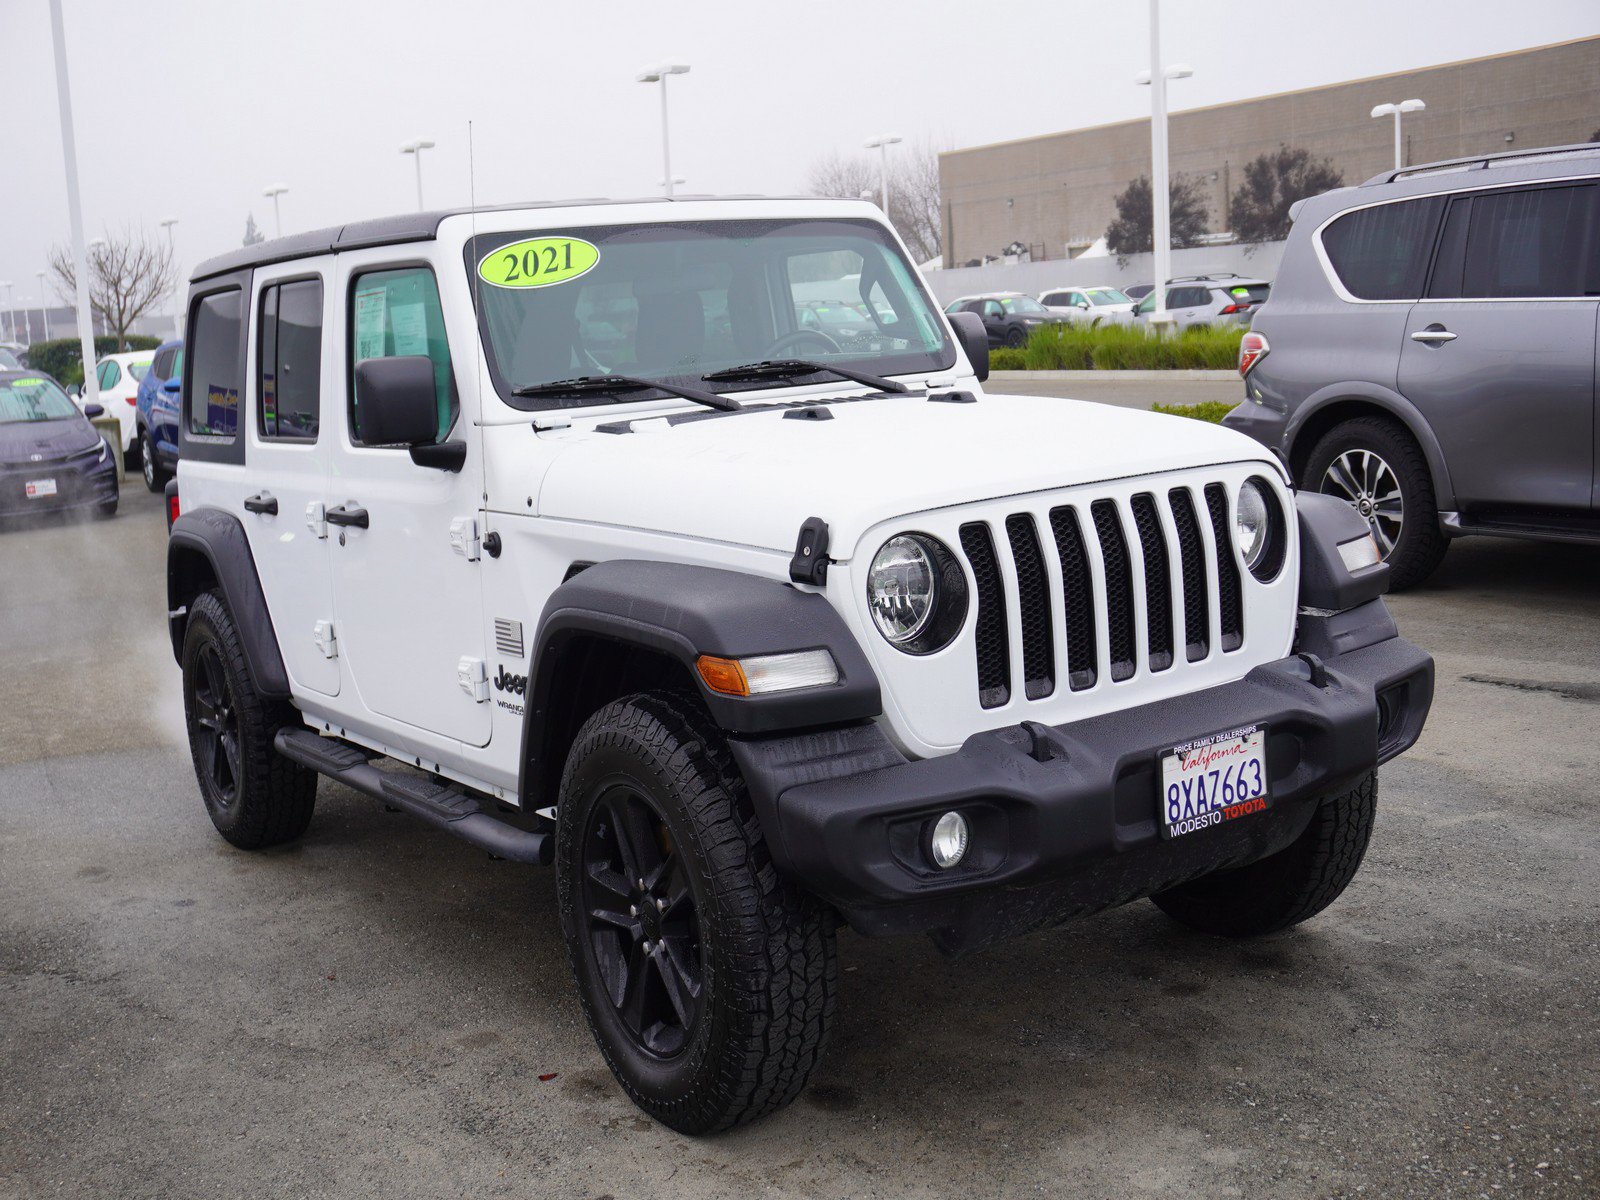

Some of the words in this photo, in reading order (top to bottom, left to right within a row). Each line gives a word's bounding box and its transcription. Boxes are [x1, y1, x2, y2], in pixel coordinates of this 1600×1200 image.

[503, 242, 575, 282] 2021
[1173, 744, 1192, 754] PRICE
[1193, 737, 1215, 749] FAMILY
[1216, 725, 1257, 743] DEALERSHIPS
[1182, 740, 1247, 771] California
[1168, 758, 1262, 822] 8XAZ663
[1170, 811, 1221, 838] MODESTO
[1224, 798, 1266, 820] TOYOTA
